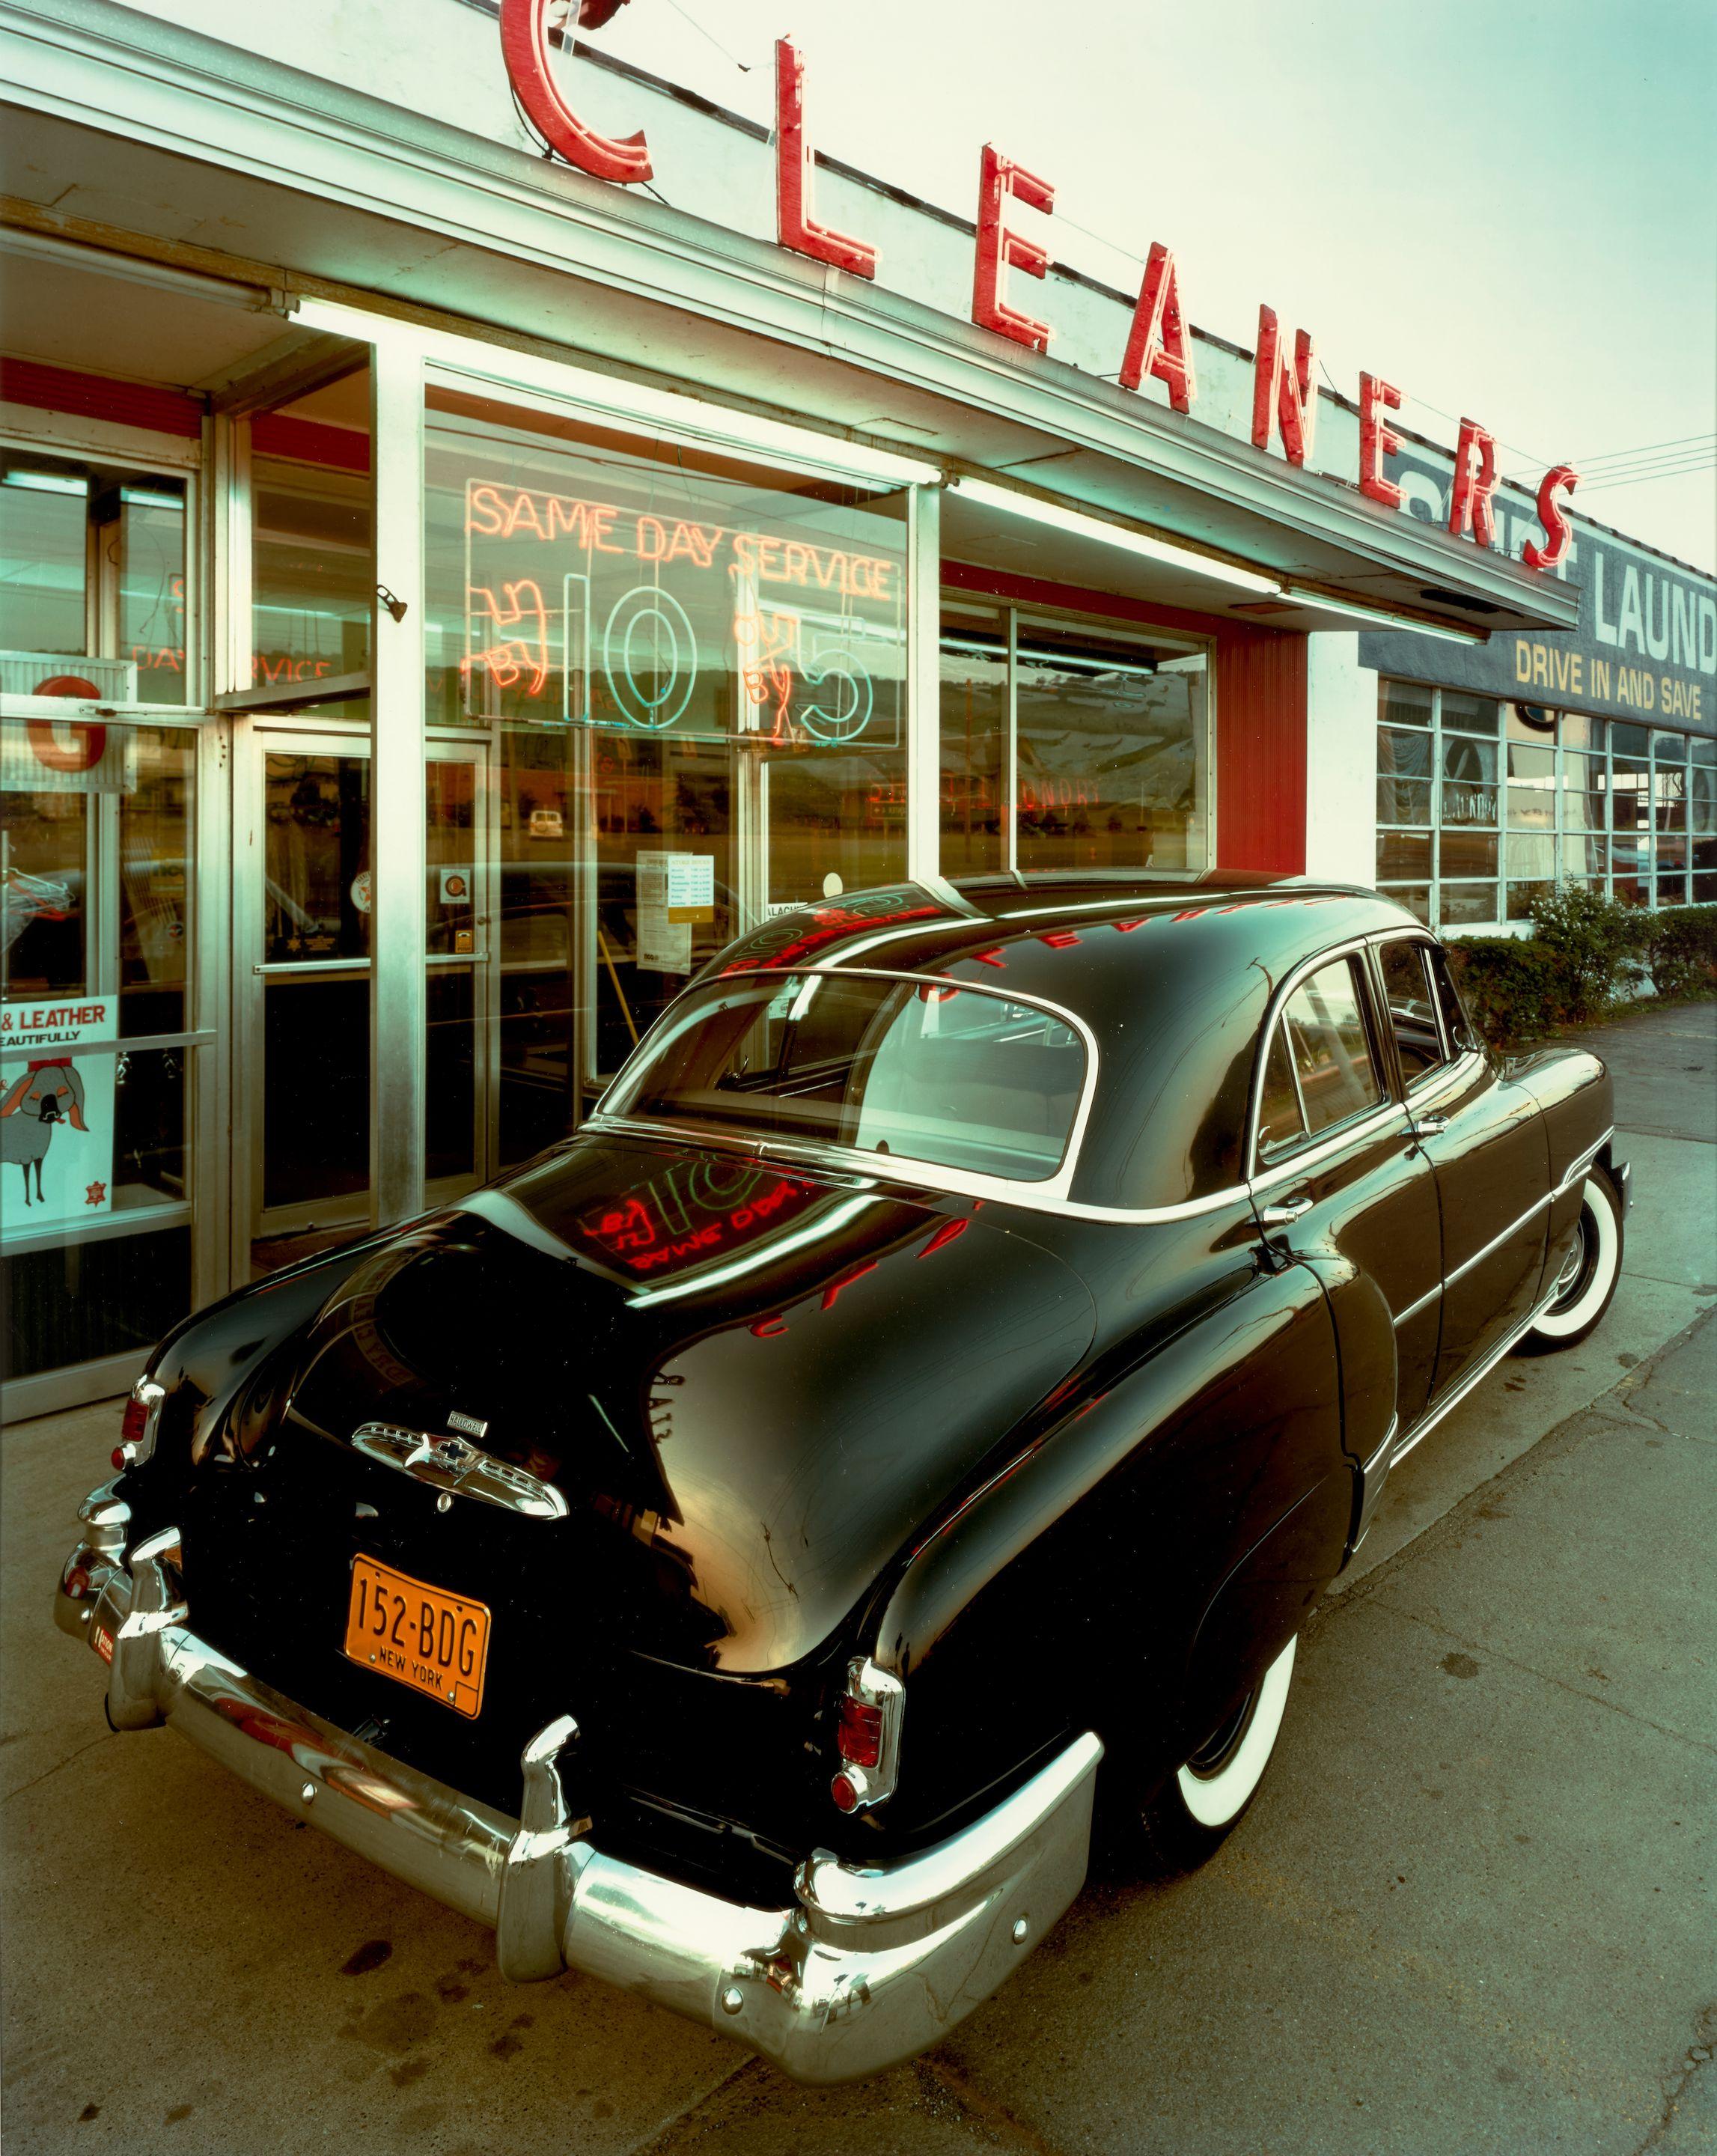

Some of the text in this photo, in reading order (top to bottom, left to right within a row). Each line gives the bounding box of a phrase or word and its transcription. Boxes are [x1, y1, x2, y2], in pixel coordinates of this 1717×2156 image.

[499, 0, 1582, 568] CLEANERS
[465, 487, 892, 601] SAME DAY SERVICE
[487, 640, 548, 695] BY
[564, 573, 698, 730] 10
[795, 614, 873, 741] 5
[1516, 639, 1702, 720] DRIVE IN AND SAVE
[742, 663, 792, 749] BY
[1, 1005, 106, 1031] & LEATHER
[359, 1577, 478, 1677] 152-BDG
[379, 1645, 444, 1690] NEW YORK
